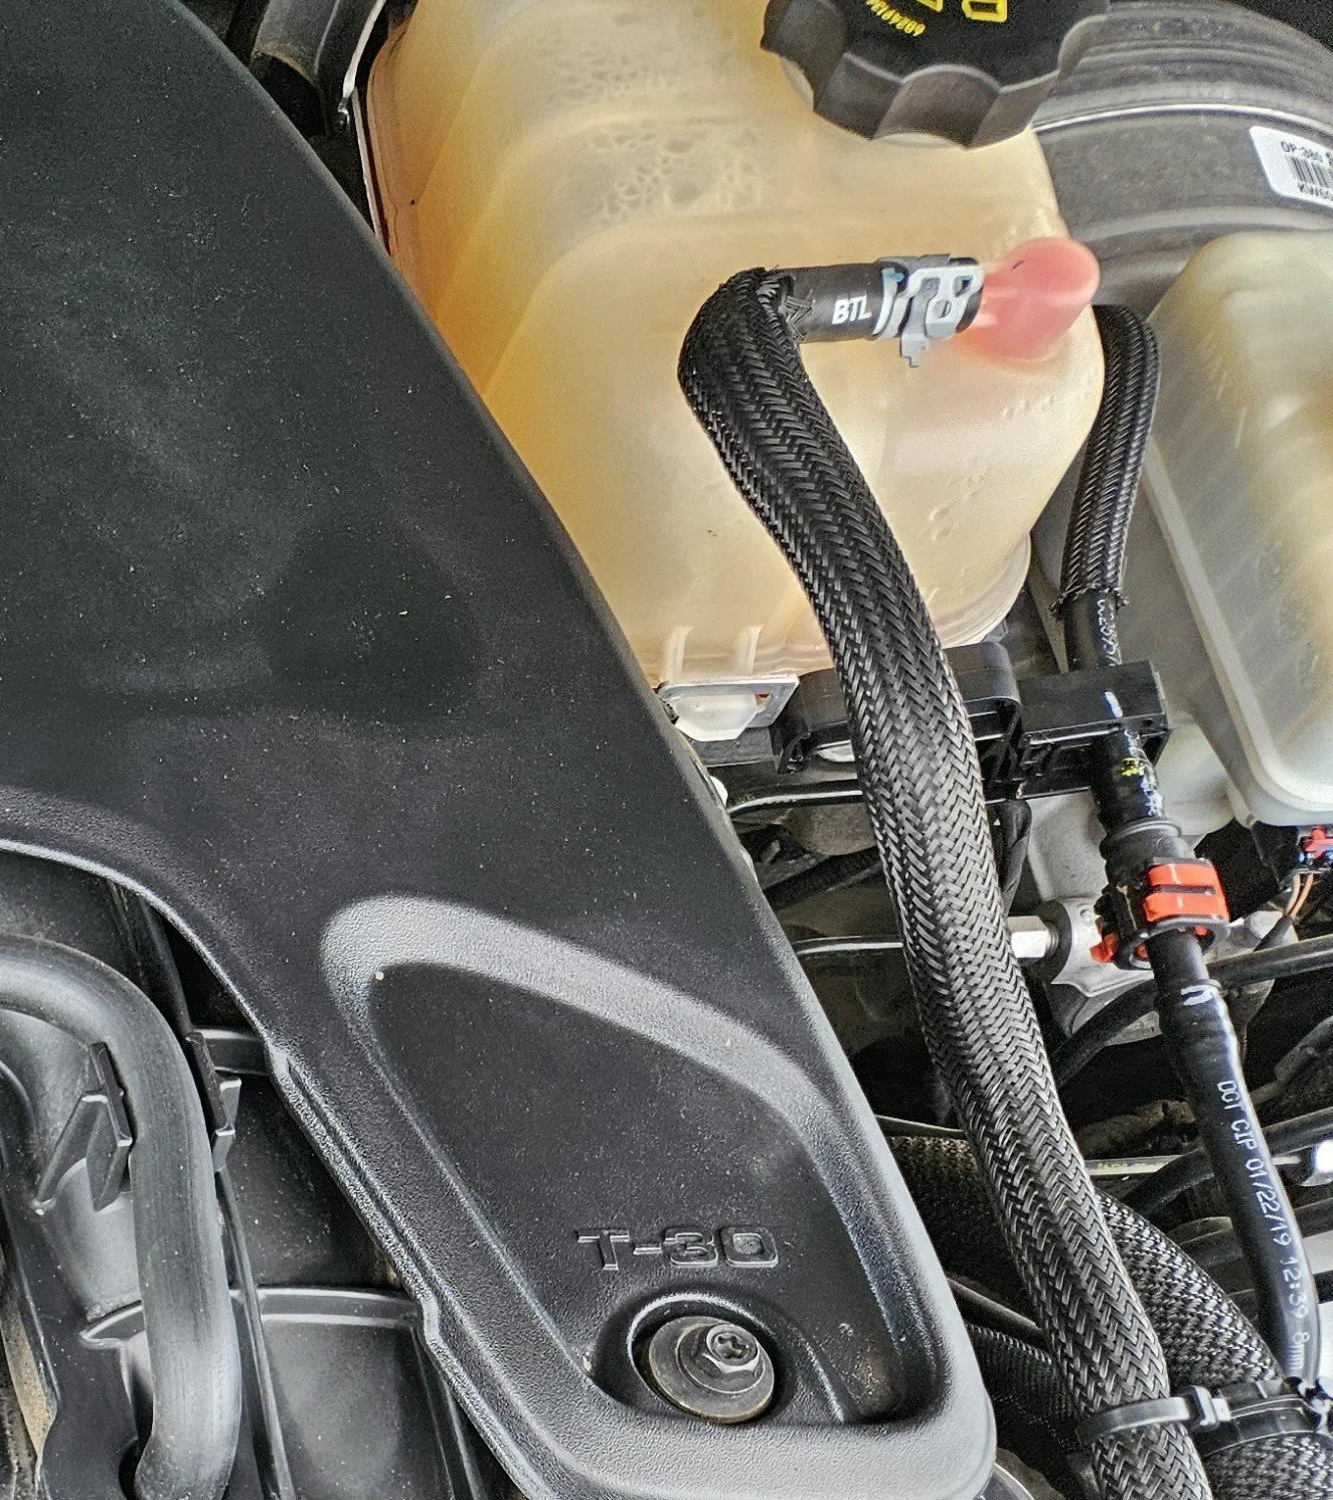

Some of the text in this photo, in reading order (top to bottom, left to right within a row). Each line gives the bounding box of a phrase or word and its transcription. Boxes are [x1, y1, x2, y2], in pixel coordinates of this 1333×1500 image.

[832, 295, 872, 325] BTL
[1231, 1119, 1258, 1150] CIP
[1245, 1158, 1292, 1246] 01/22/19
[576, 1224, 780, 1271] T-30
